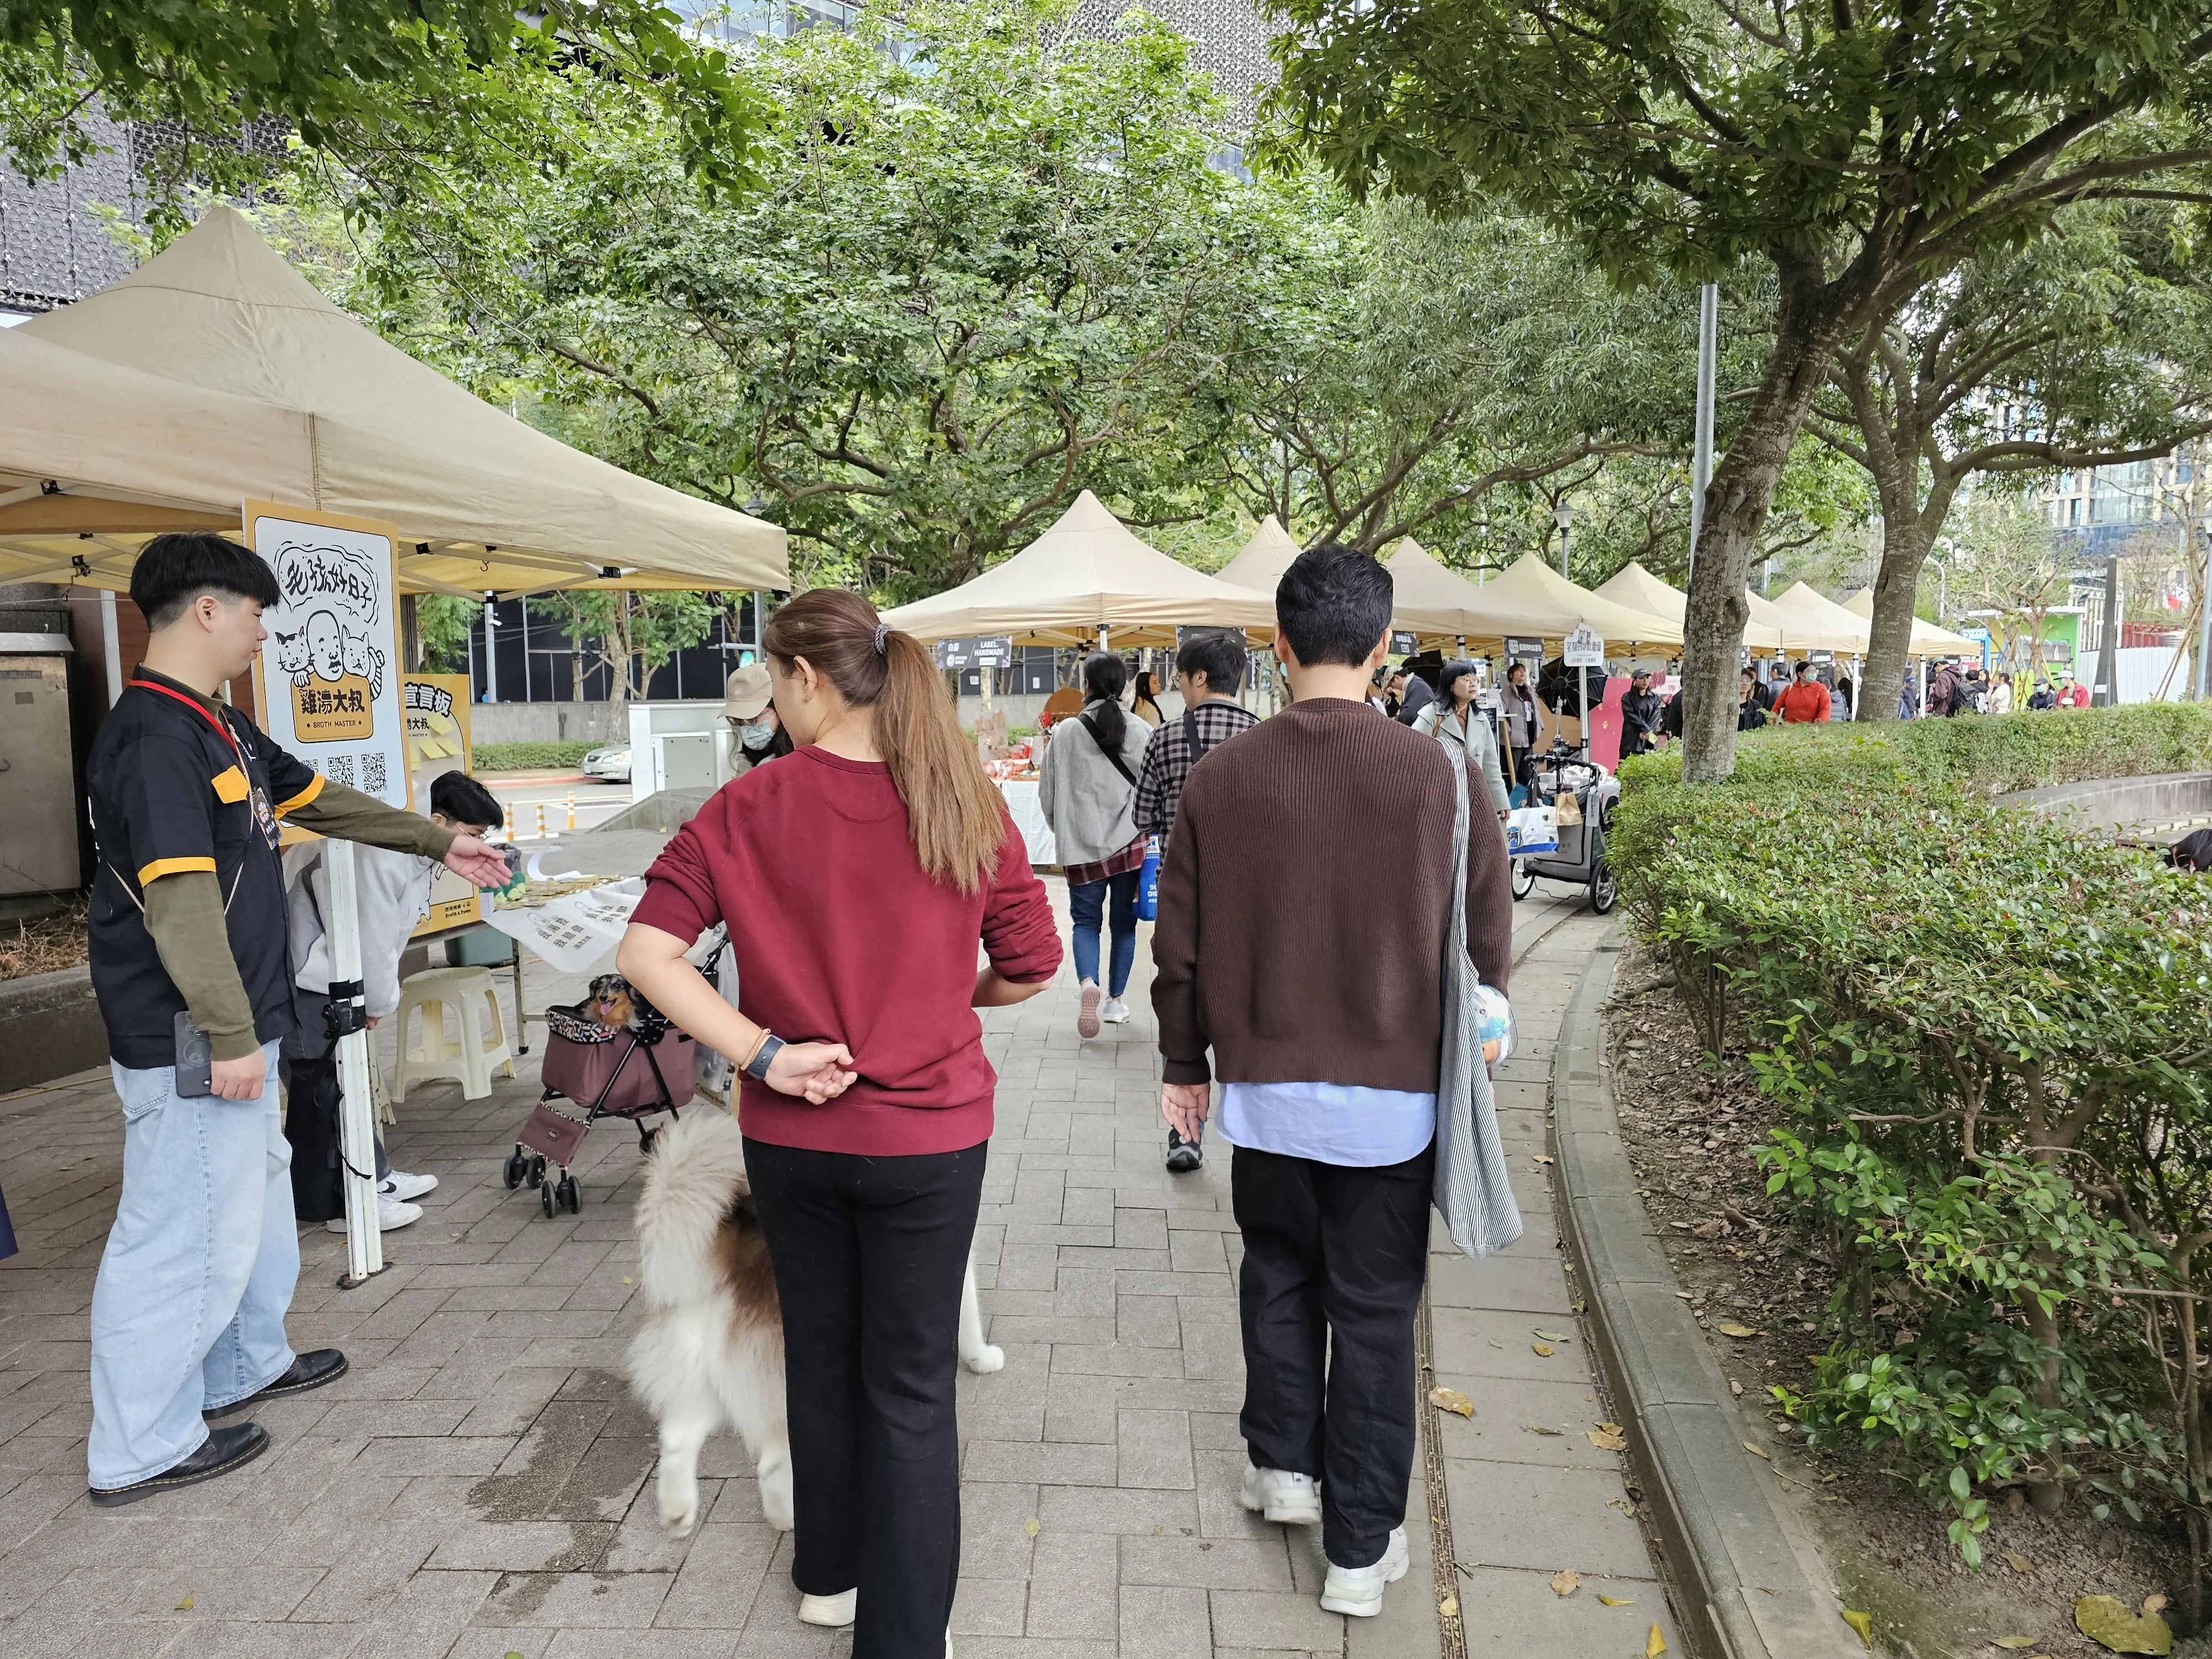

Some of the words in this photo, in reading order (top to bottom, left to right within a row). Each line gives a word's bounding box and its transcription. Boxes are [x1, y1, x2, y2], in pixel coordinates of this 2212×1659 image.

[285, 554, 372, 609] 毛孩好日子
[974, 648, 1004, 656] HANDMADE
[299, 688, 365, 714] 雞湯大叔
[404, 682, 452, 718] 宣言板
